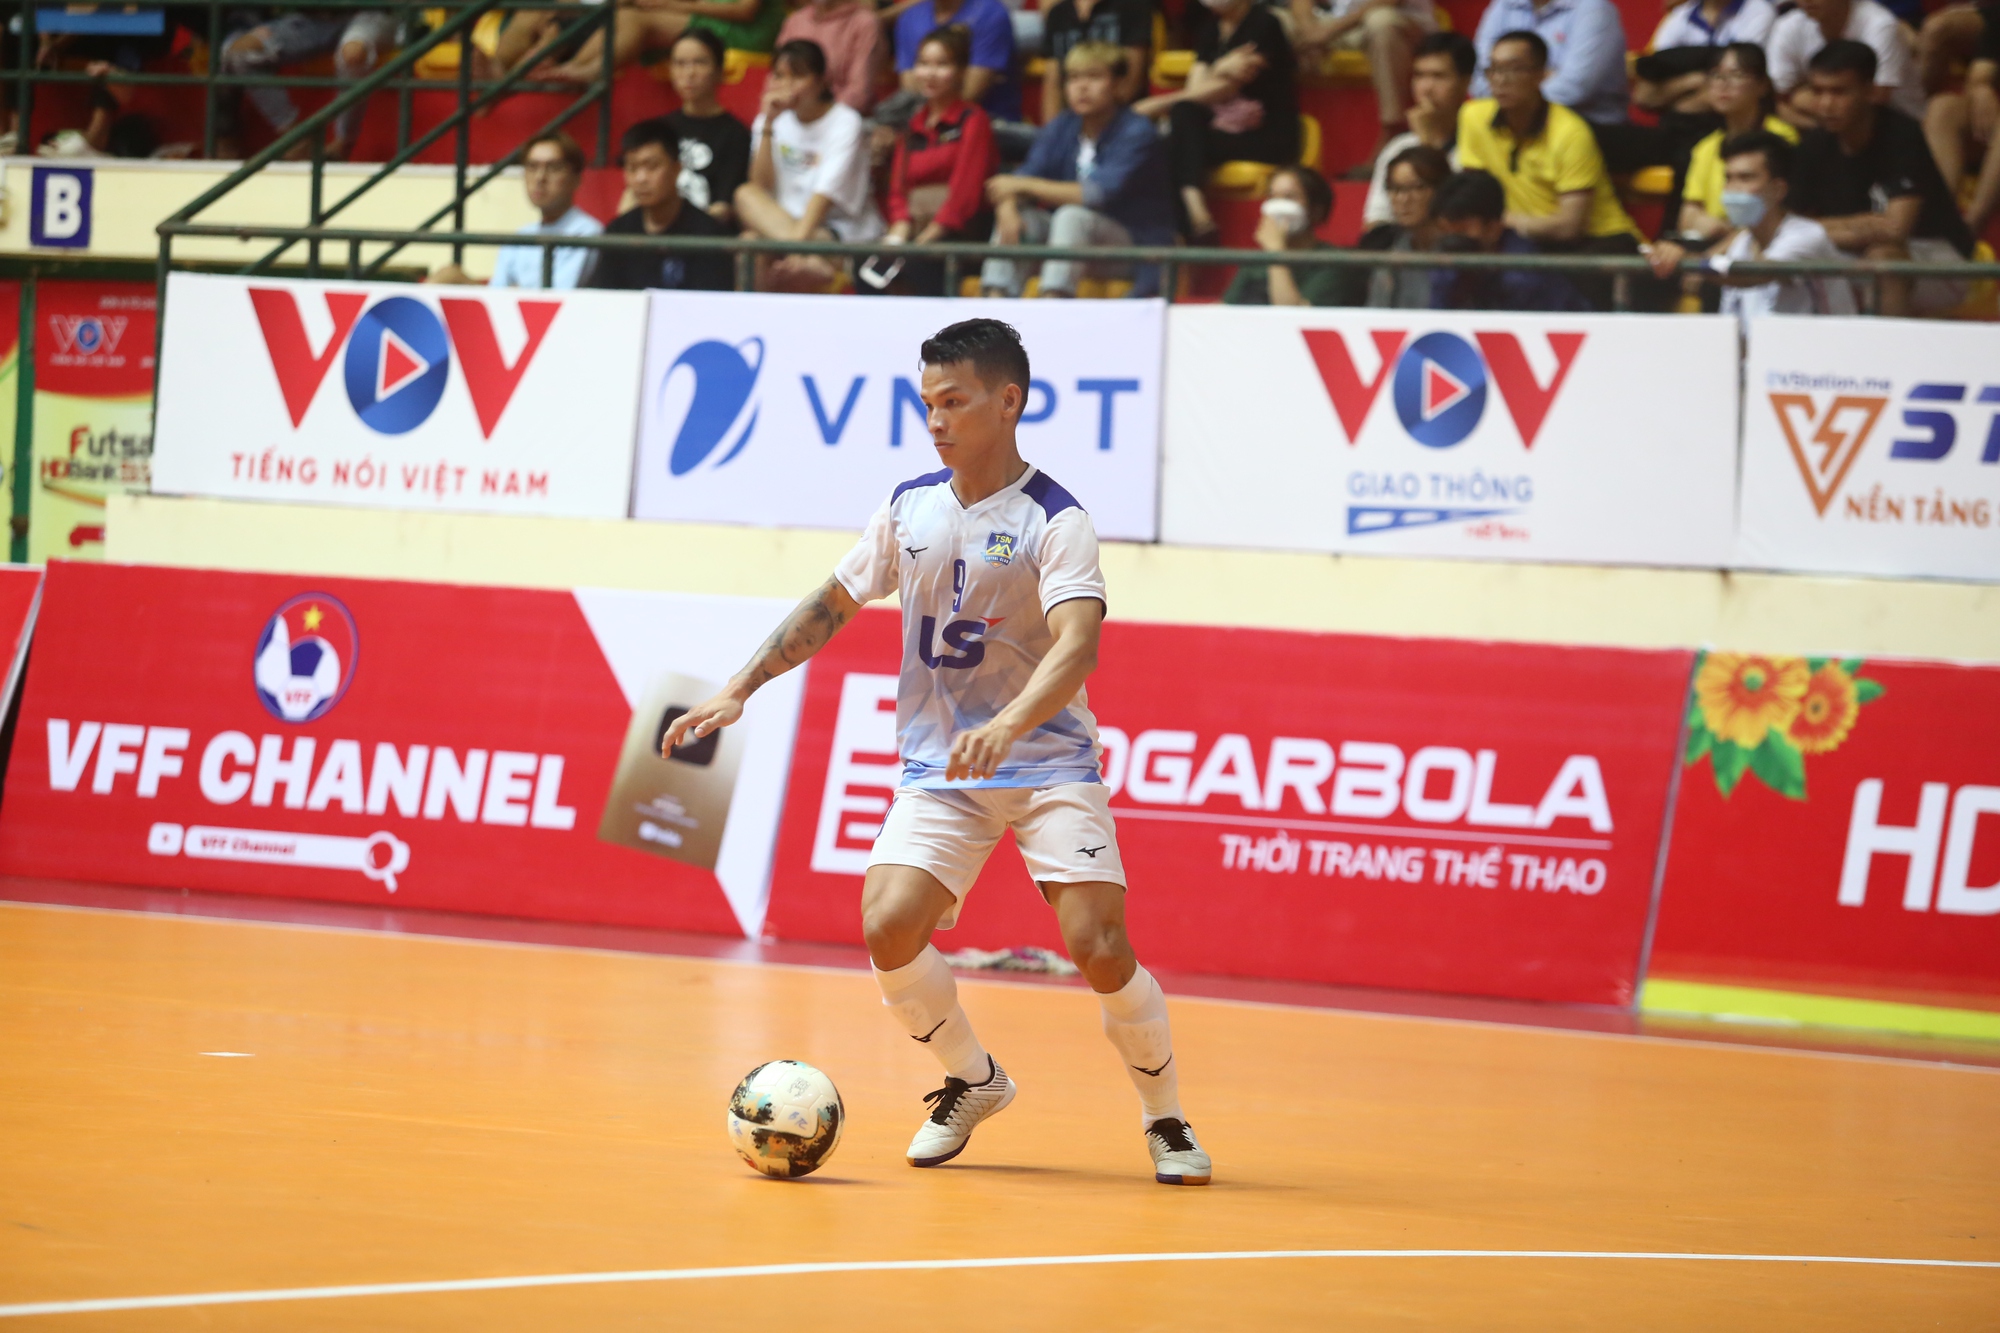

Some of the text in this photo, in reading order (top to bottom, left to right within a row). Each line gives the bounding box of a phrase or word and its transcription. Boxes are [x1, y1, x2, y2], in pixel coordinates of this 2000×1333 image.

[44, 173, 82, 239] B
[248, 287, 564, 442] VOV
[1299, 328, 1588, 451] VOV
[231, 445, 549, 502] TIẾNG NÓI VIỆT NAM
[1347, 468, 1534, 502] GIAO THÔNG
[995, 534, 1013, 544] TSN
[952, 558, 966, 613] 9
[919, 615, 986, 669] LS
[46, 718, 577, 830] VFF CHANNEL
[1305, 839, 1426, 884] TRANG
[1506, 852, 1607, 896] THAO
